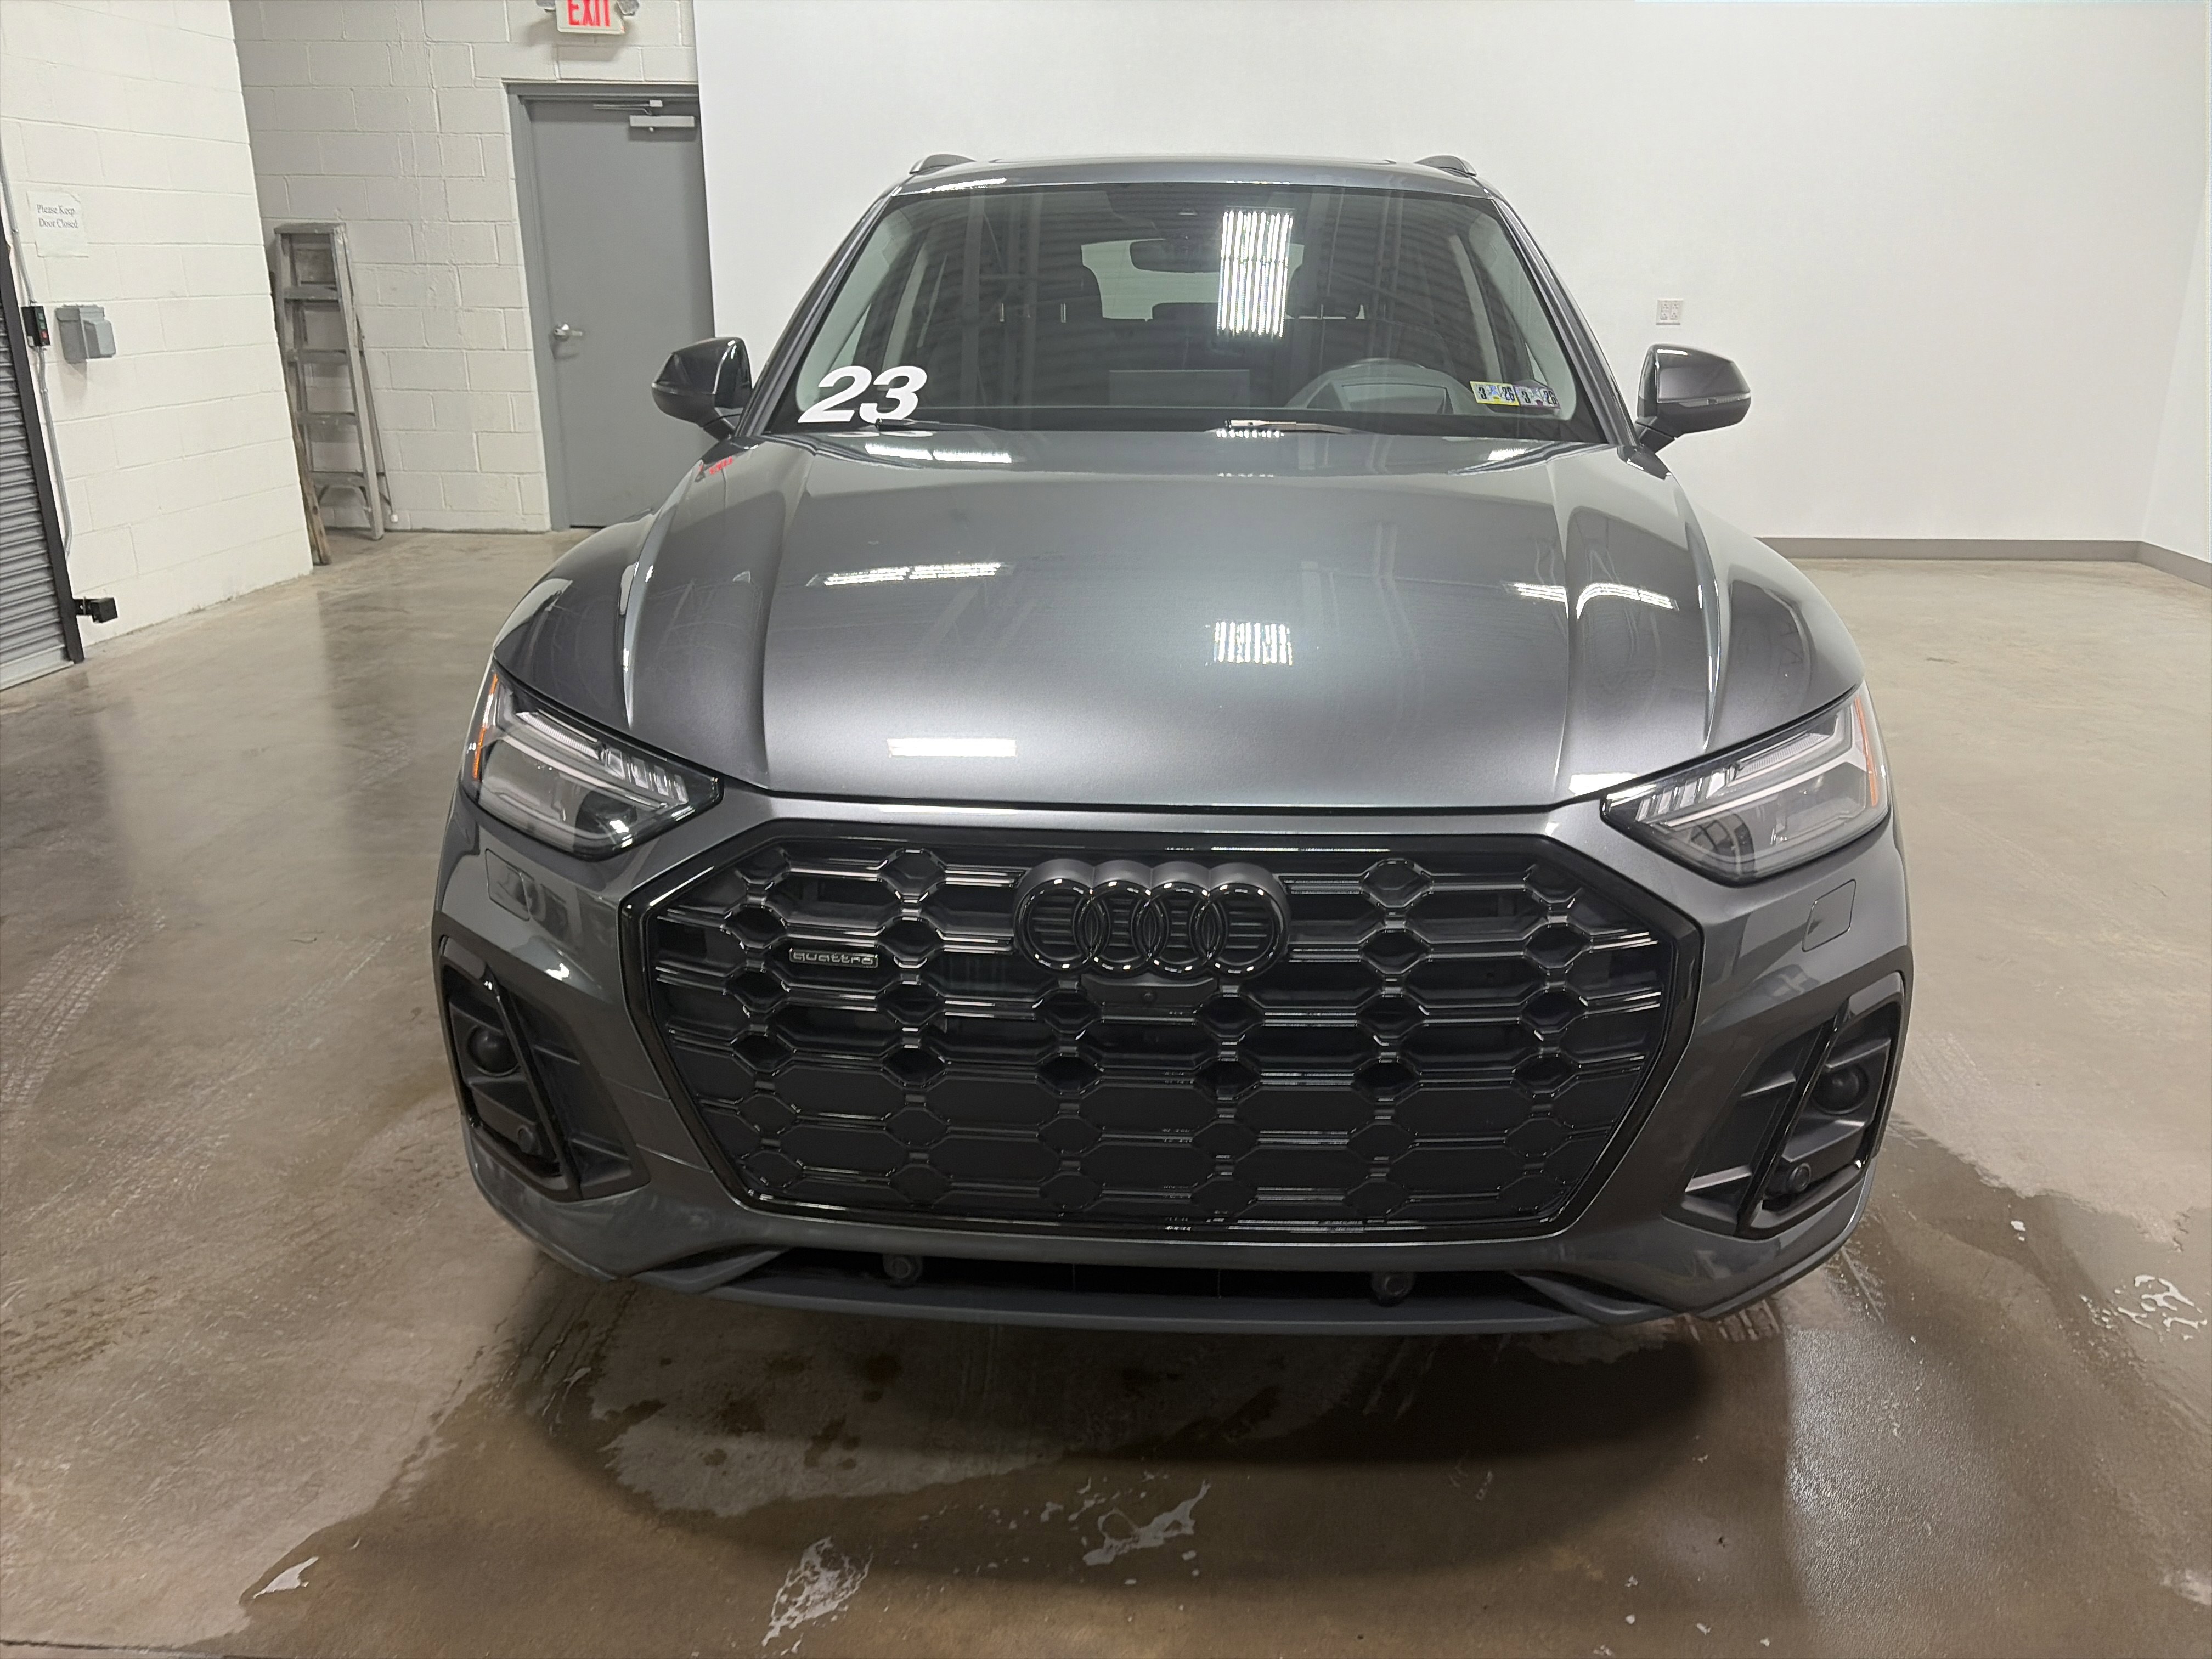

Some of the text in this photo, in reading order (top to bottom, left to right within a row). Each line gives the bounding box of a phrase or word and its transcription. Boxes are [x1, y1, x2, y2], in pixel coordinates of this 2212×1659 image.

[567, 0, 611, 27] EXIT
[37, 204, 75, 217] Please Keep
[38, 217, 78, 228] Door Closed
[797, 365, 927, 424] 23
[1478, 387, 1516, 402] 3 26
[1521, 390, 1558, 405] 3 26
[793, 952, 873, 965] quattro
